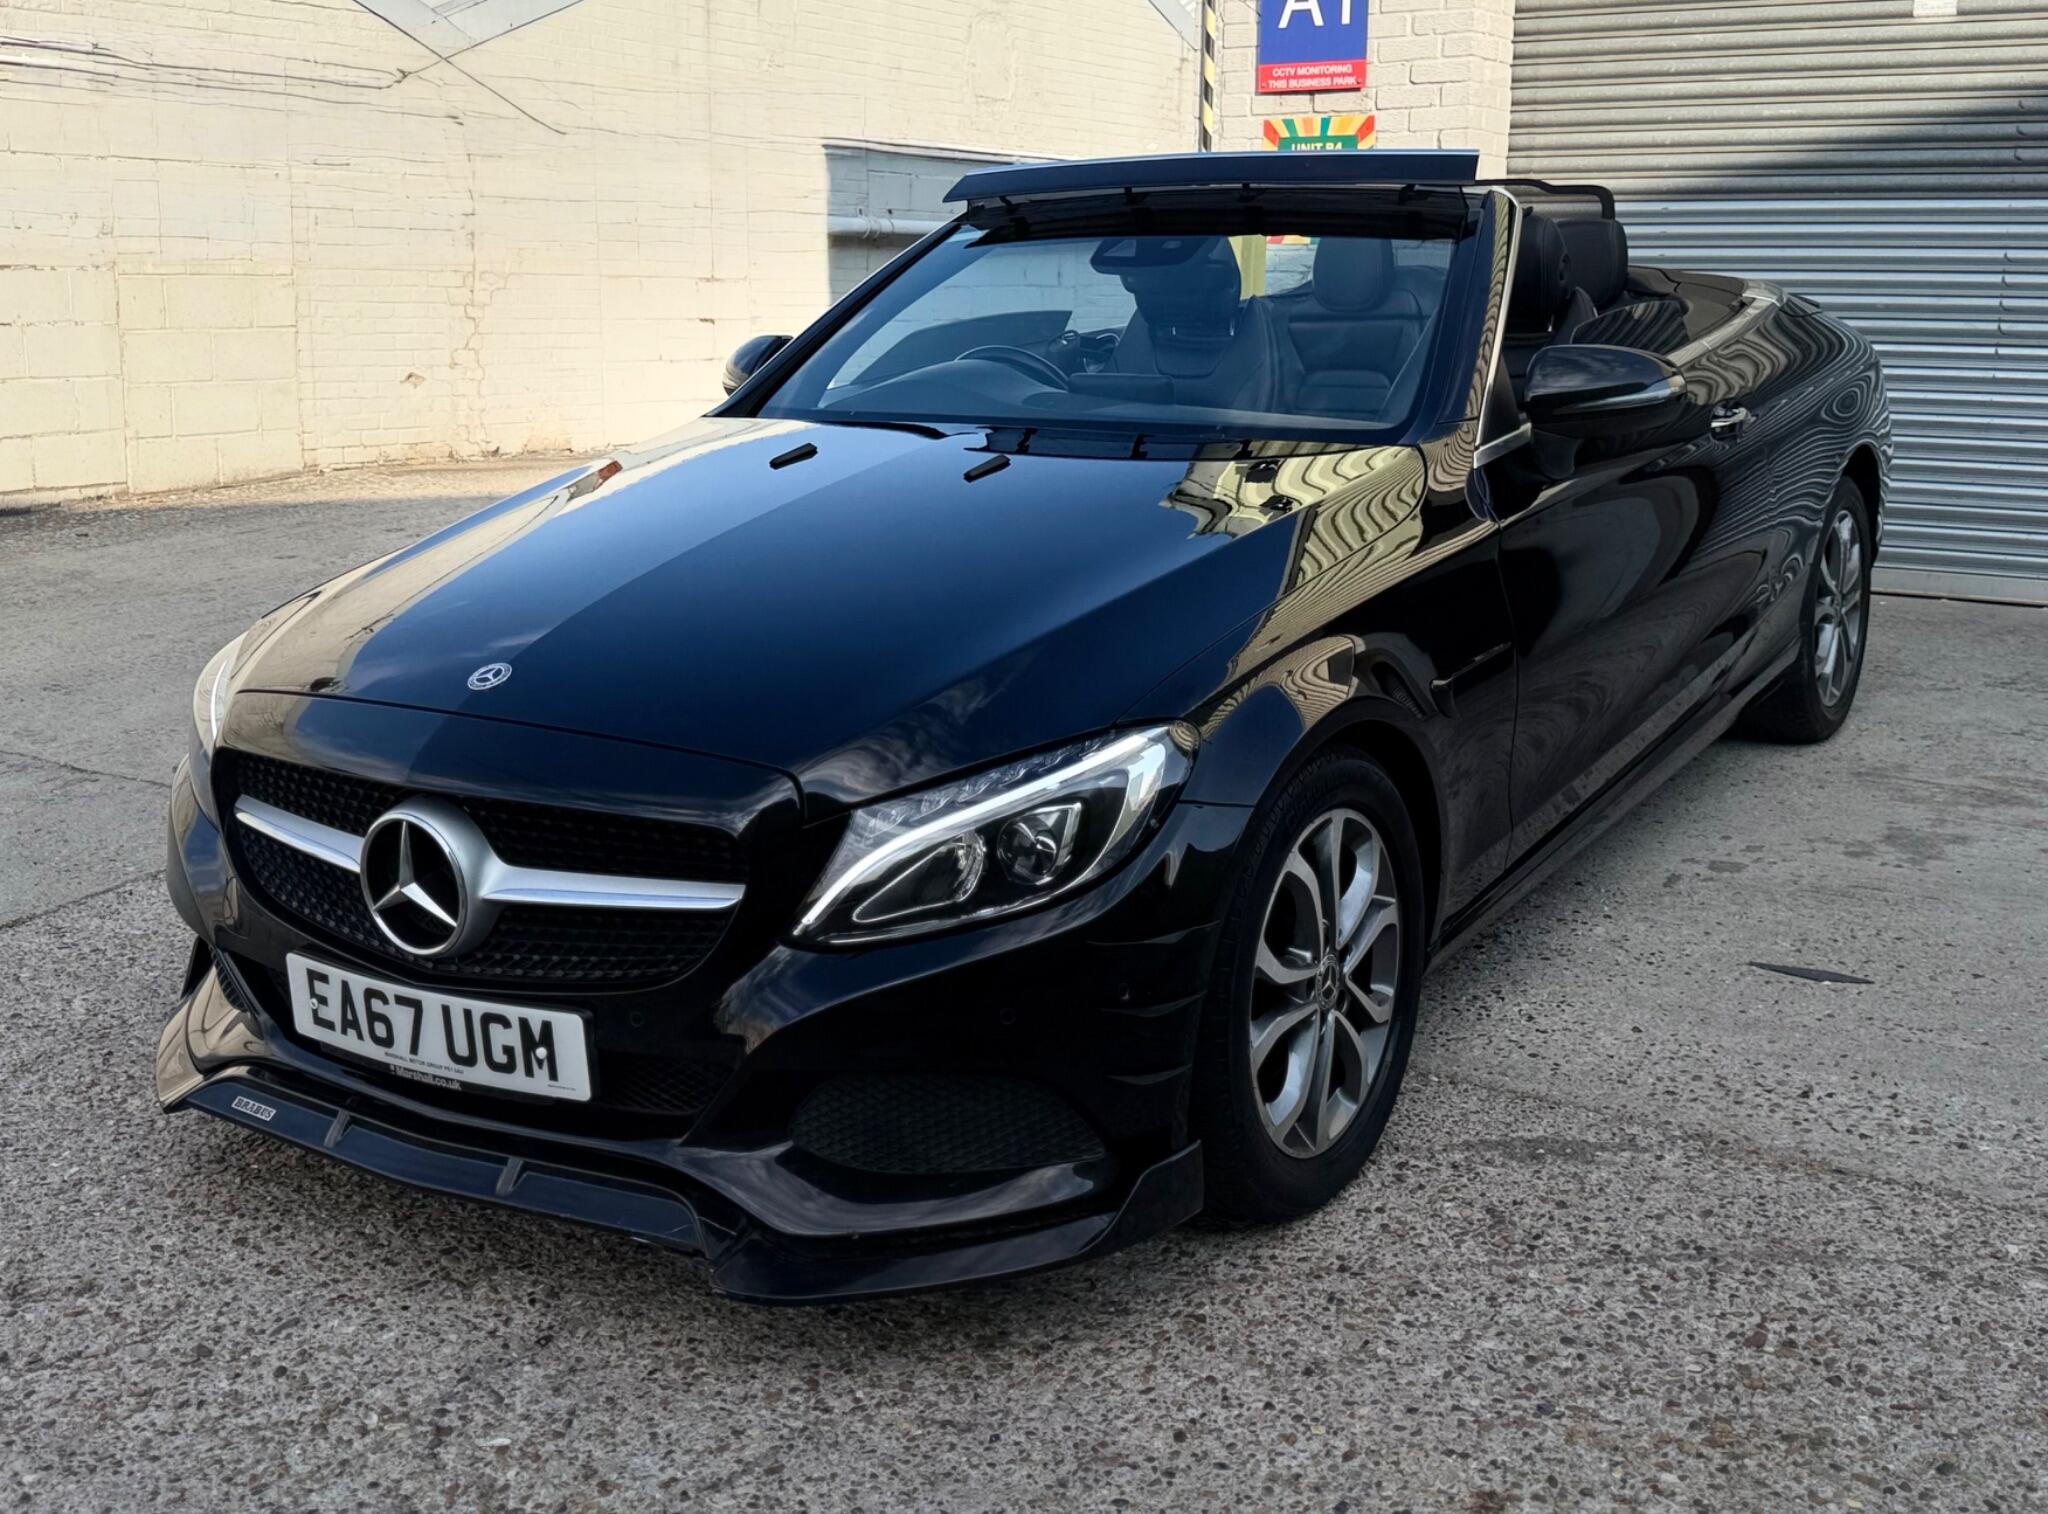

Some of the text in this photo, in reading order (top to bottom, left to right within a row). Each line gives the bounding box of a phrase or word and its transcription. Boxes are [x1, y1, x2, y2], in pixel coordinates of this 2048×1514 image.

[1278, 0, 1351, 28] A1
[1272, 64, 1352, 77] CCTV MONITORING
[1268, 76, 1357, 89] THIS BUSINESS PARK
[1291, 143, 1323, 151] UNIT
[306, 967, 559, 1082] EA67 UGM
